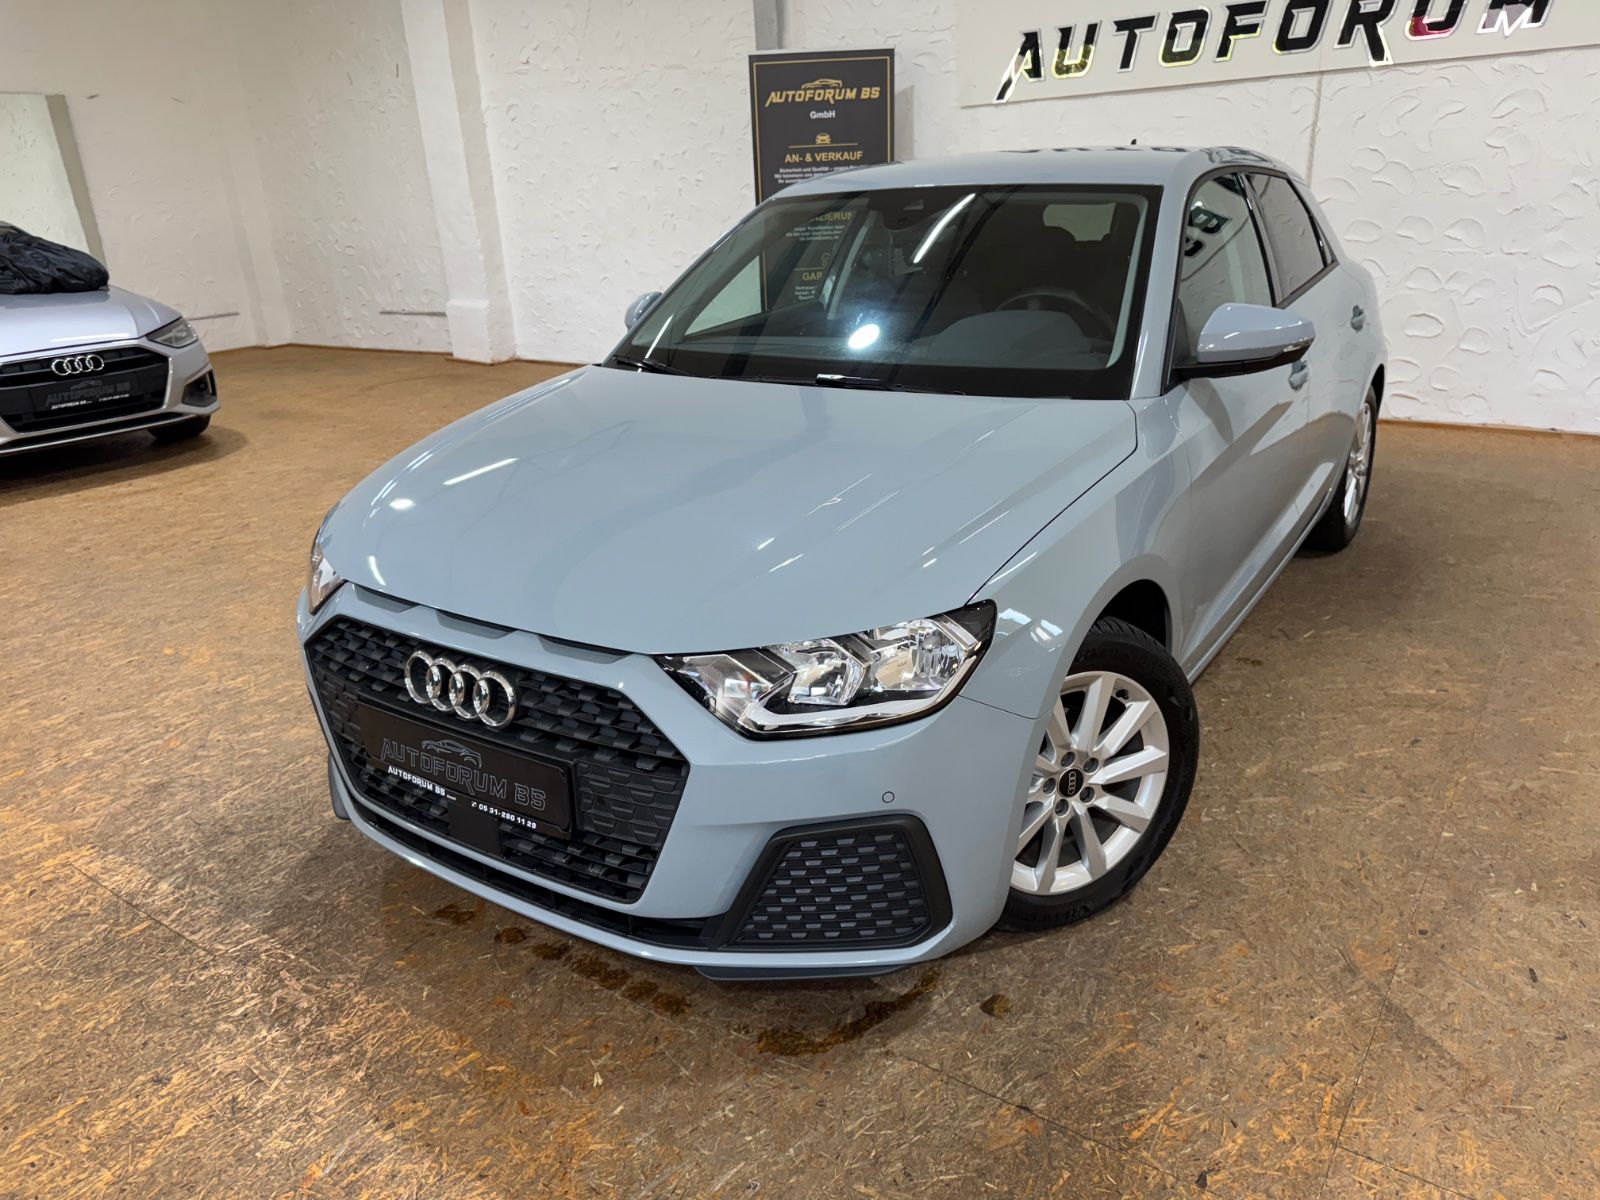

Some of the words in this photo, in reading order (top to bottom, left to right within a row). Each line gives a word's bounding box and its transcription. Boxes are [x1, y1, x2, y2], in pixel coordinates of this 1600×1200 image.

[995, 0, 1552, 104] AUTOFORUM
[765, 88, 857, 107] AUTOFORUM
[860, 87, 881, 99] BS
[809, 110, 836, 119] GmbH
[784, 153, 803, 163] AN-
[805, 152, 813, 162] &
[815, 151, 864, 162] VERKAUF
[380, 738, 507, 799] AUTOFORUM
[515, 782, 546, 811] BS
[388, 765, 433, 792] AUTOFORUM
[435, 784, 446, 797] BS
